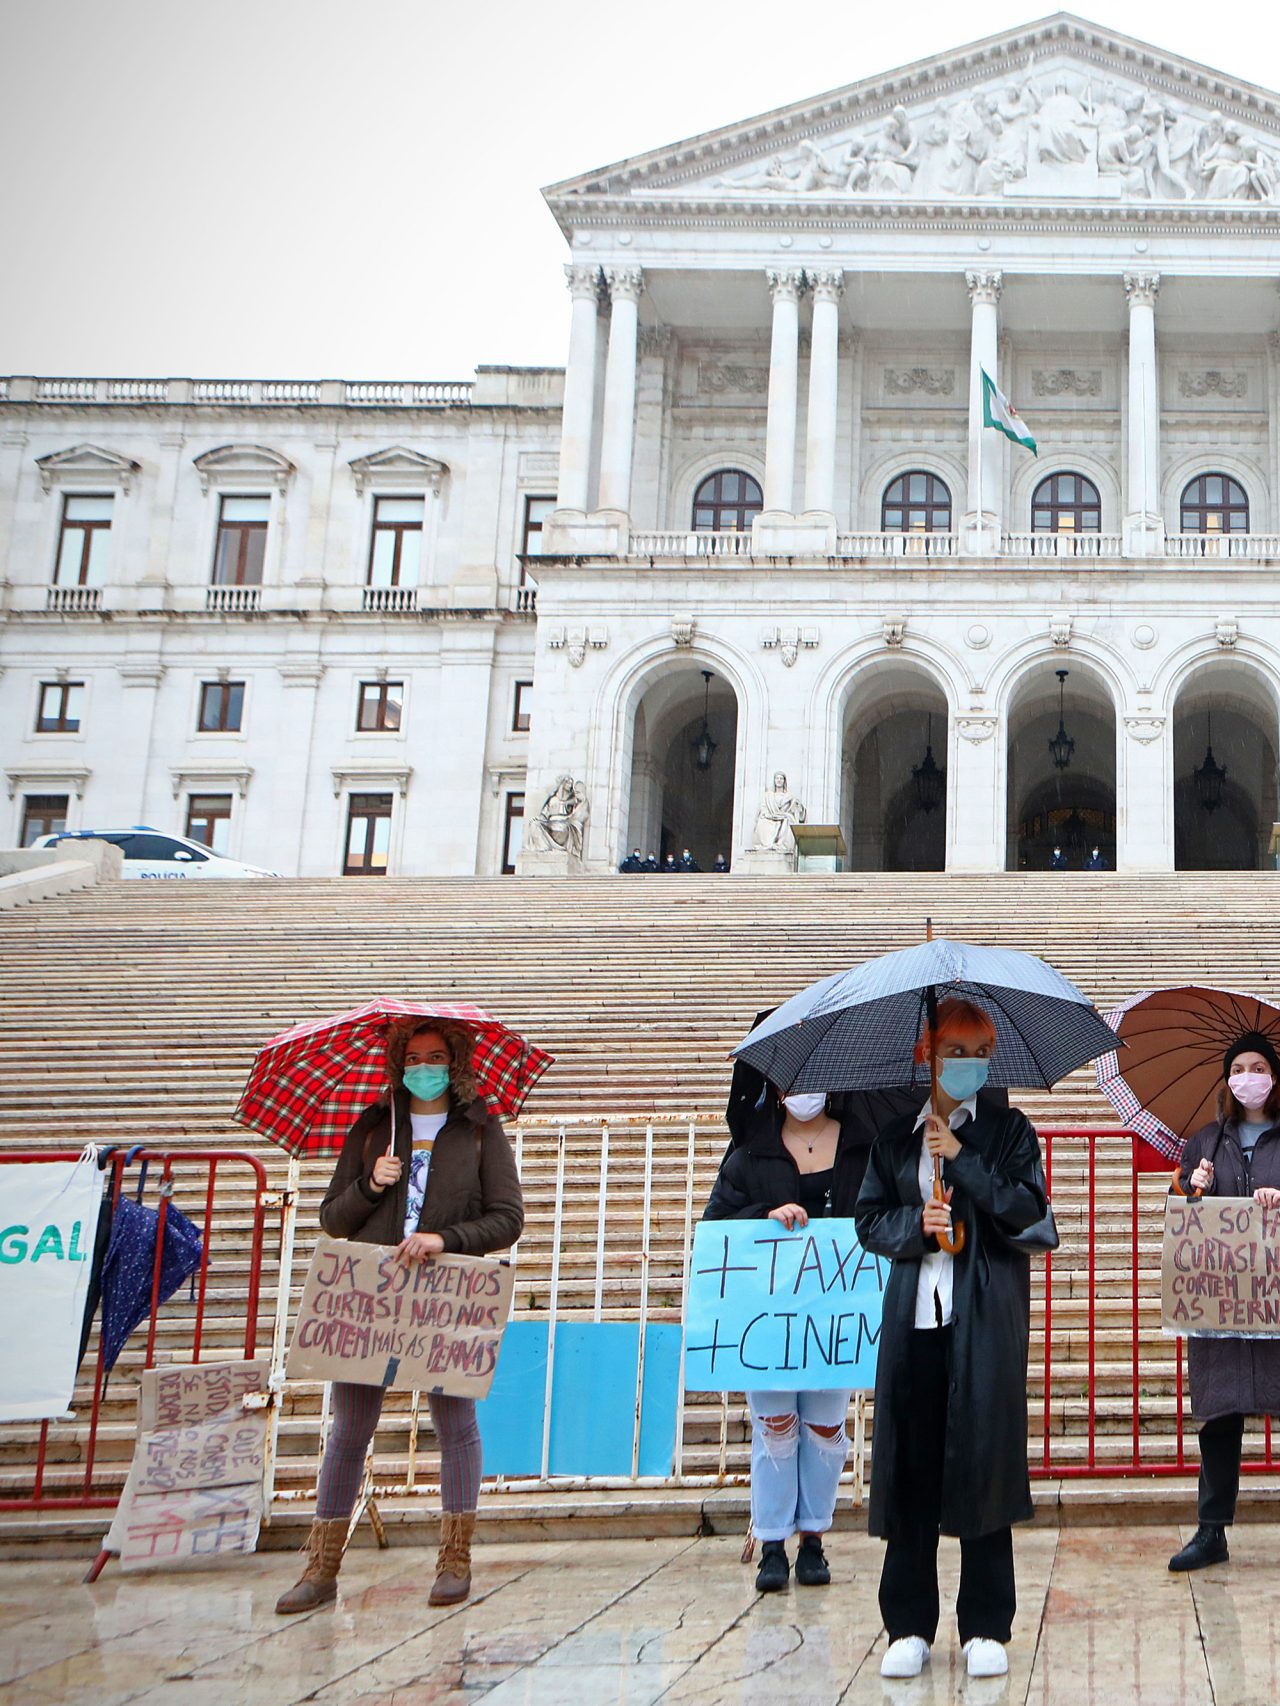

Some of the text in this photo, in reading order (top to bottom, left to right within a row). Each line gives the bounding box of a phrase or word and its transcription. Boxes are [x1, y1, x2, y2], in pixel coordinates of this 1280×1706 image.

[1169, 1205, 1205, 1236] JÁ
[1219, 1206, 1254, 1235] SÓ
[0, 1219, 87, 1265] GAL
[1173, 1238, 1258, 1273] CURTAS!
[412, 1257, 501, 1300] FAZEMOS
[1171, 1271, 1240, 1300] CORTEM
[312, 1289, 500, 1331] CURTAS! NÃO NOS
[1171, 1296, 1205, 1322] AS
[298, 1318, 371, 1360] CORTEM
[405, 1333, 428, 1359] AS
[426, 1333, 499, 1377] PERNAS
[182, 1372, 201, 1394] SE
[231, 1428, 261, 1468] QUÊ
